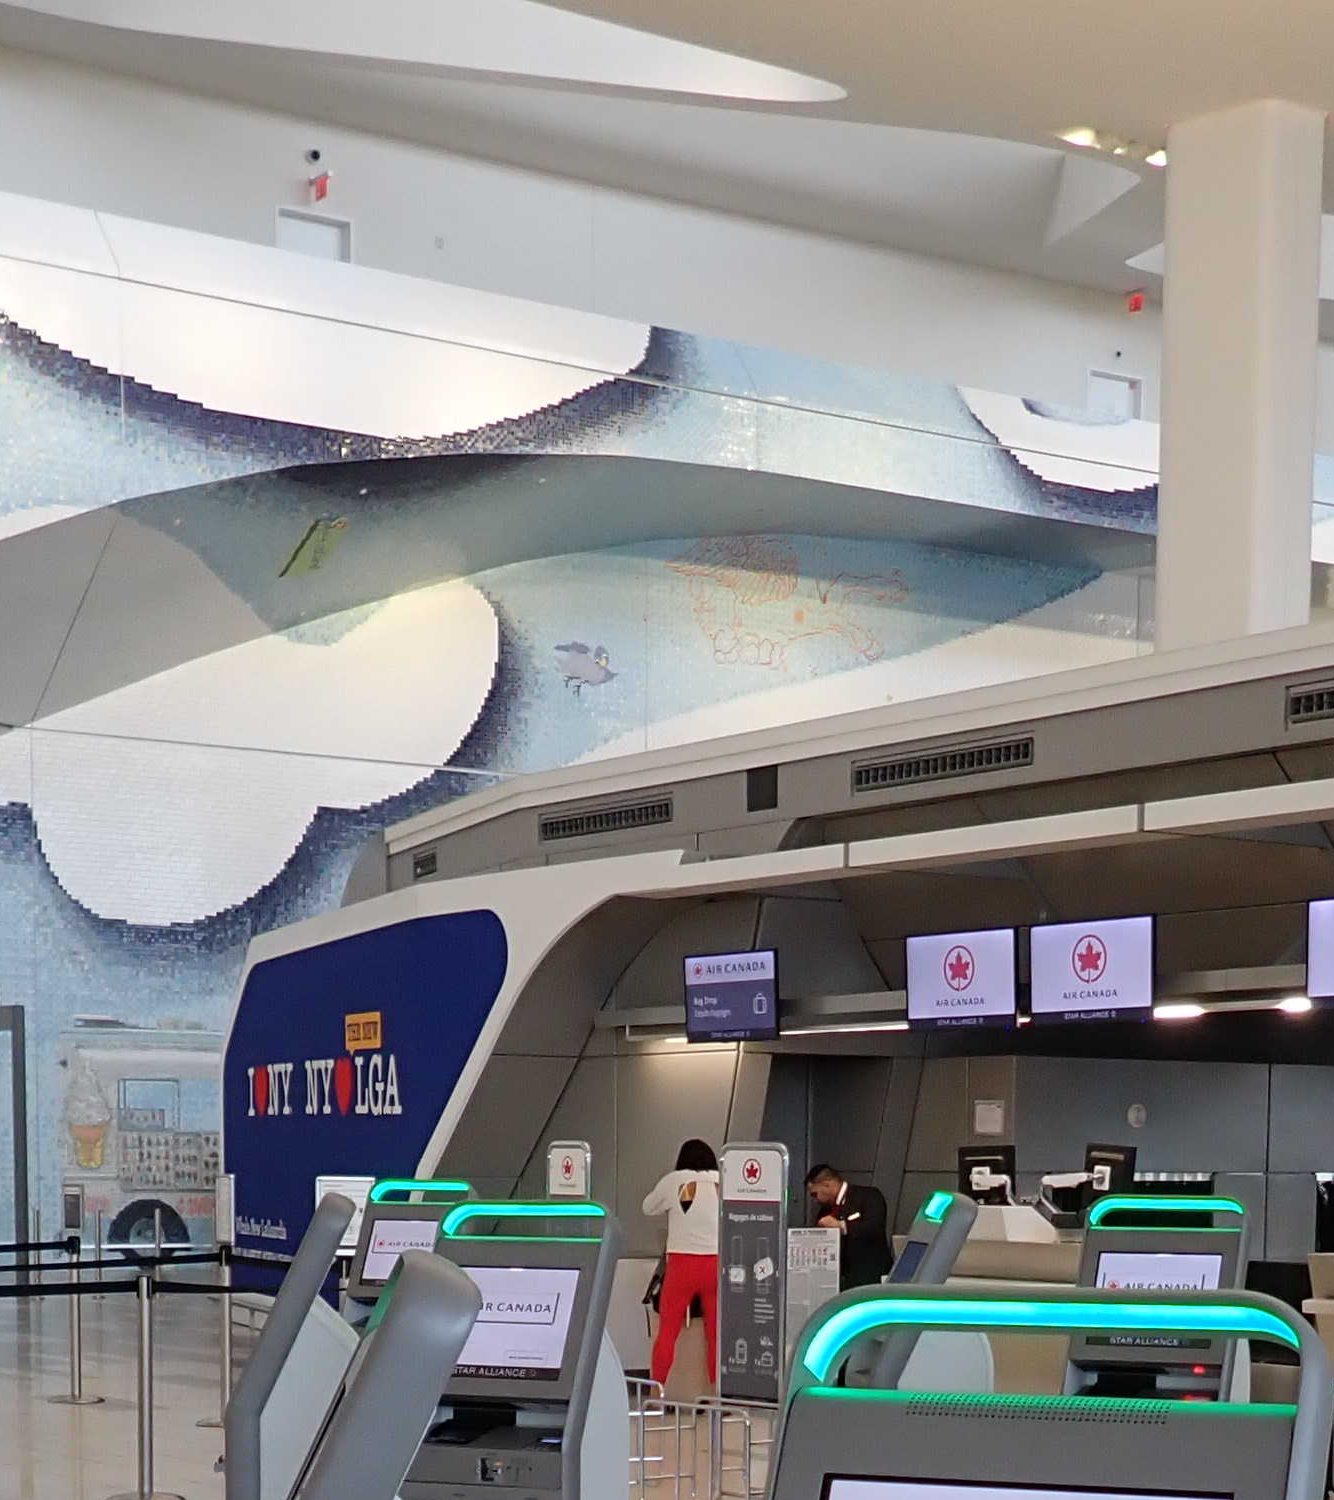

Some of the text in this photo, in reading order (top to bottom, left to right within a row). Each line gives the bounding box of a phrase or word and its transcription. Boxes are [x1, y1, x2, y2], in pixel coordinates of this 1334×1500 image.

[706, 961, 766, 975] AIR CANADA
[1062, 988, 1118, 999] AIR CANADA
[950, 997, 985, 1006] CANADA
[354, 1054, 402, 1116] LGA
[480, 1302, 551, 1313] IR CANADA
[1110, 1336, 1179, 1346] STAR ALLIANCE
[478, 1367, 527, 1378] ALLIANCE
